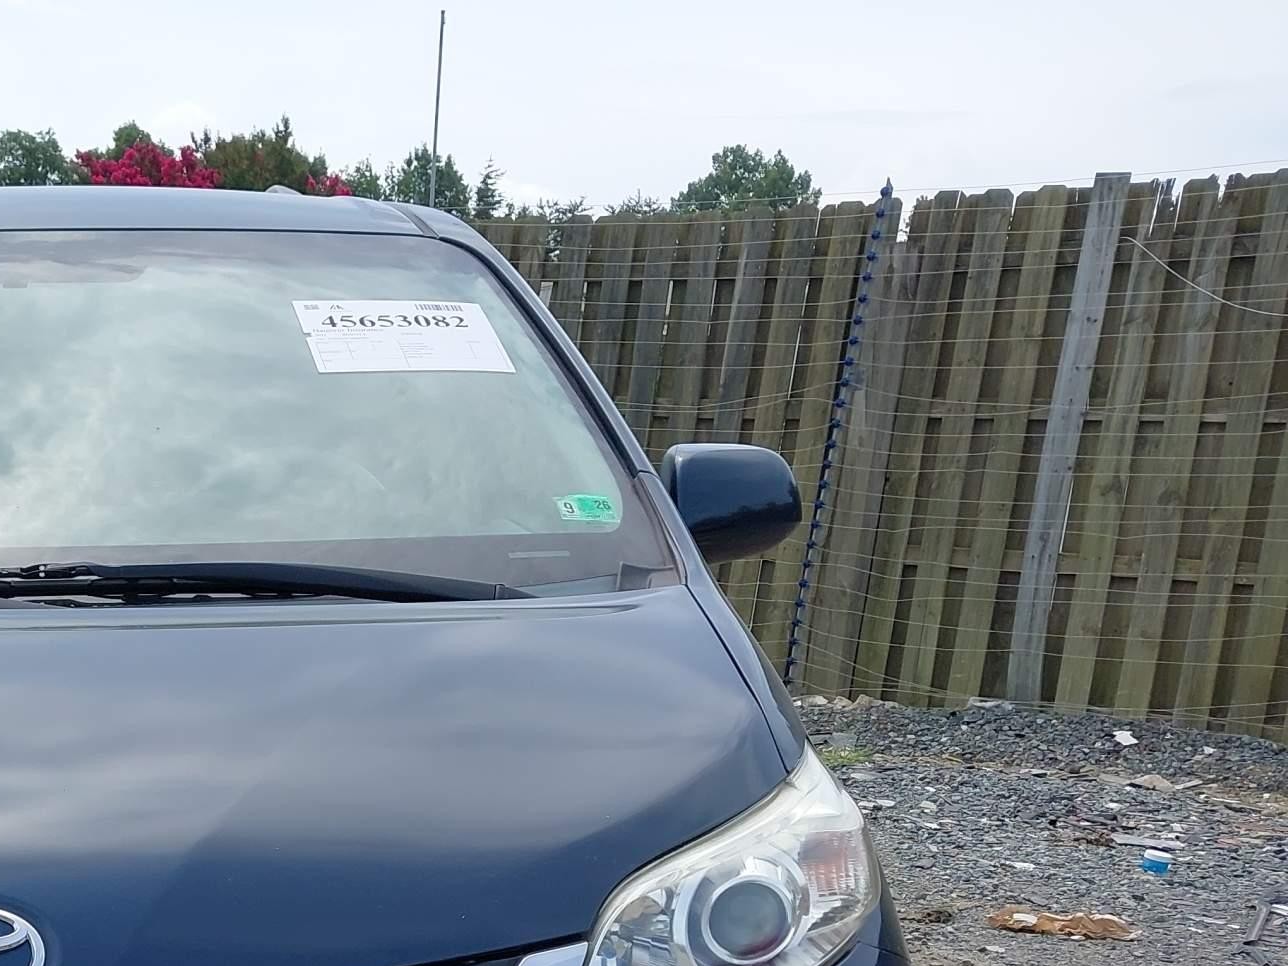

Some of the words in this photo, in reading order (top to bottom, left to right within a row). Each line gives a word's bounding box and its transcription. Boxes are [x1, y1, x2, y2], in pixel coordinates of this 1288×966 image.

[320, 314, 470, 328] 45653082
[563, 501, 575, 514] 9
[593, 499, 612, 511] 26
